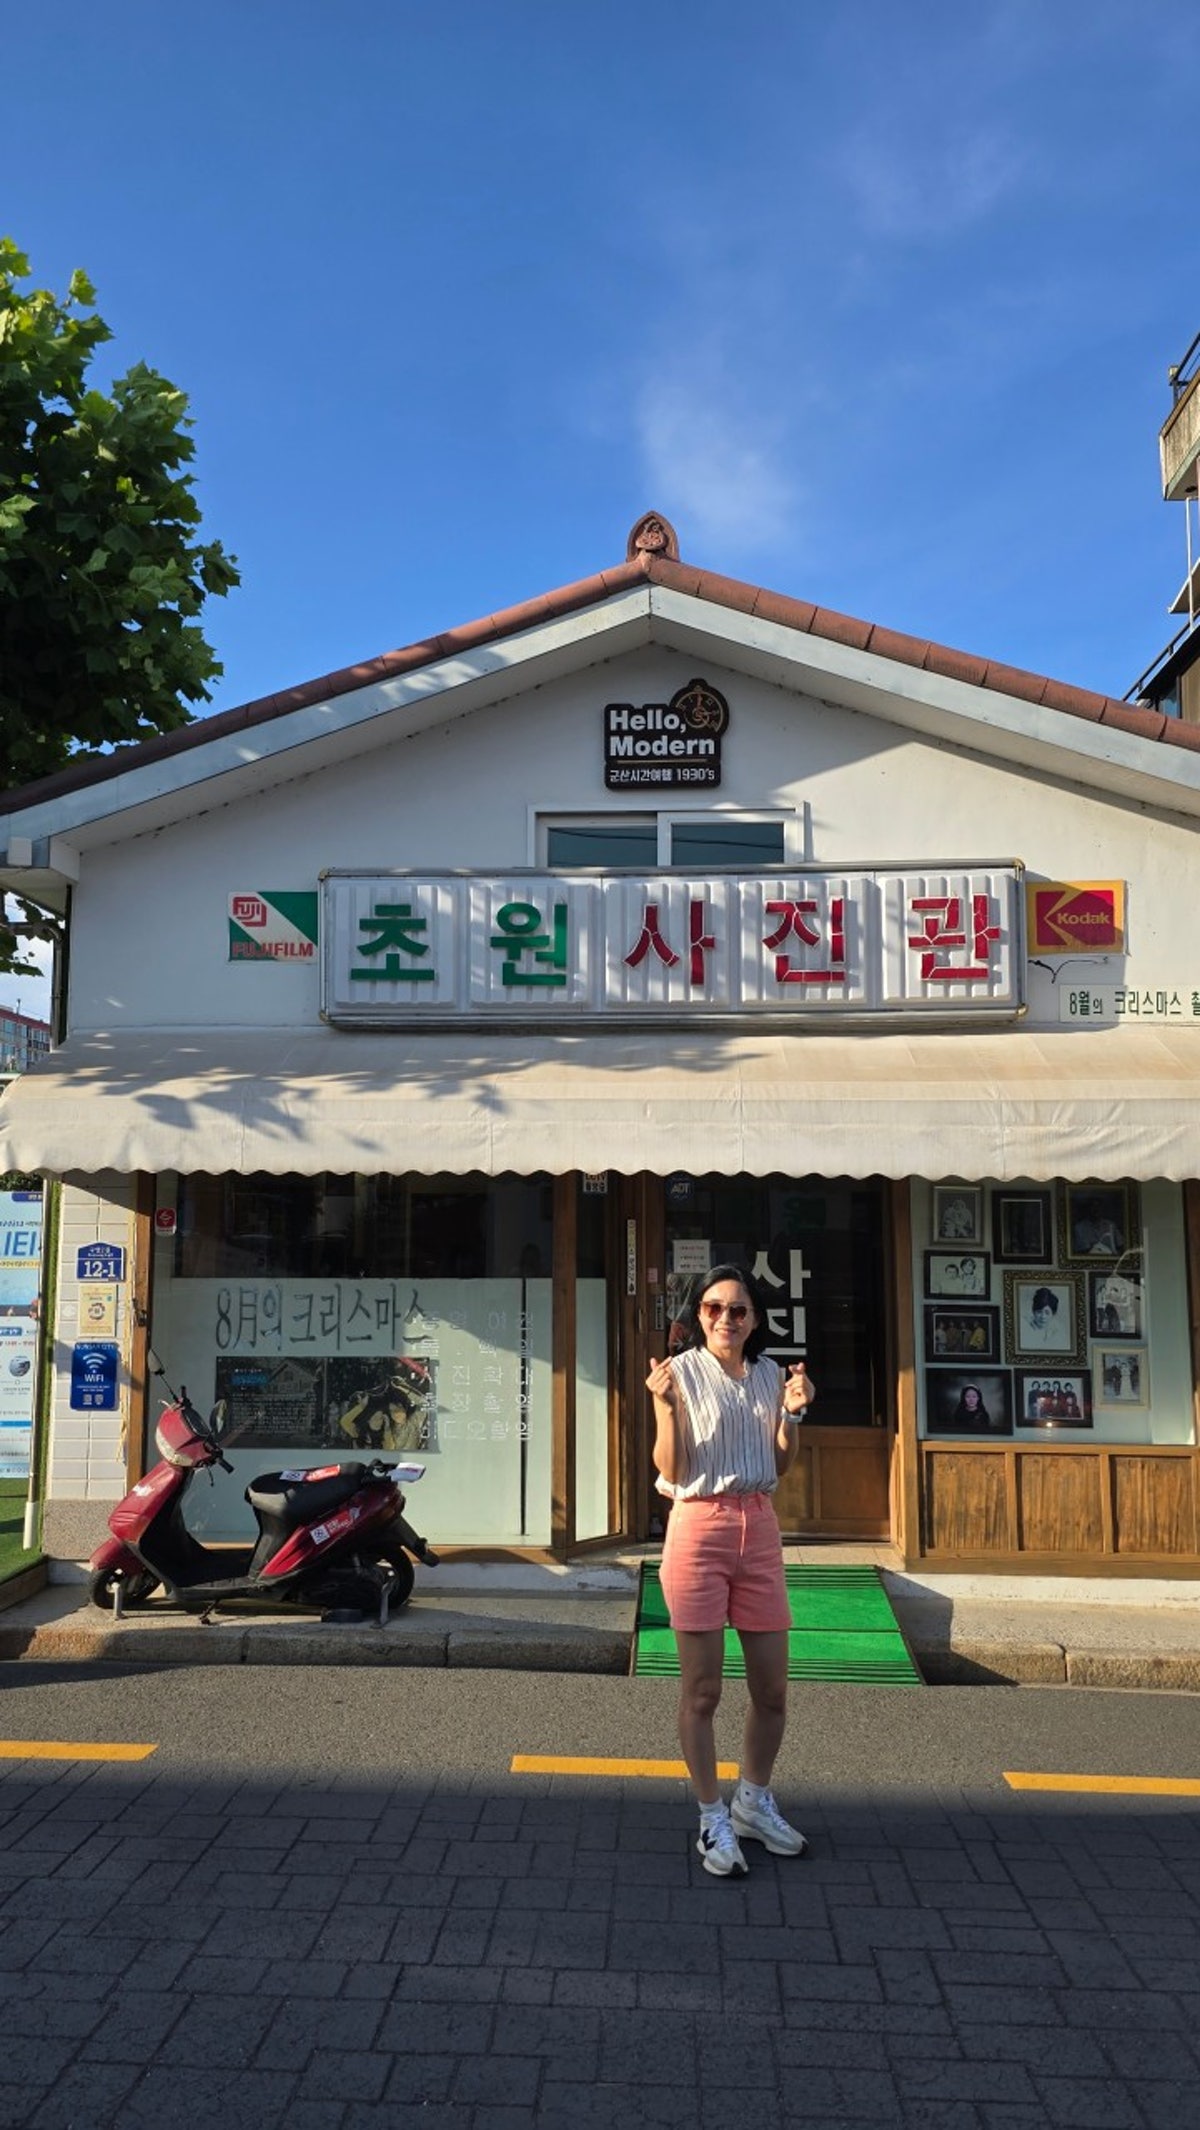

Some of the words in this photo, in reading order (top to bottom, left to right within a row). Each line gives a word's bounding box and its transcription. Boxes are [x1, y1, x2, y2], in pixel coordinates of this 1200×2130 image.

[610, 709, 687, 733] Hello,
[610, 735, 715, 756] Modern
[1057, 912, 1111, 926] Kodak
[232, 942, 314, 957] FUJIFILM
[1069, 991, 1104, 1016] 8월의
[1114, 991, 1182, 1016] 크리스마스
[83, 1260, 116, 1278] 12-1
